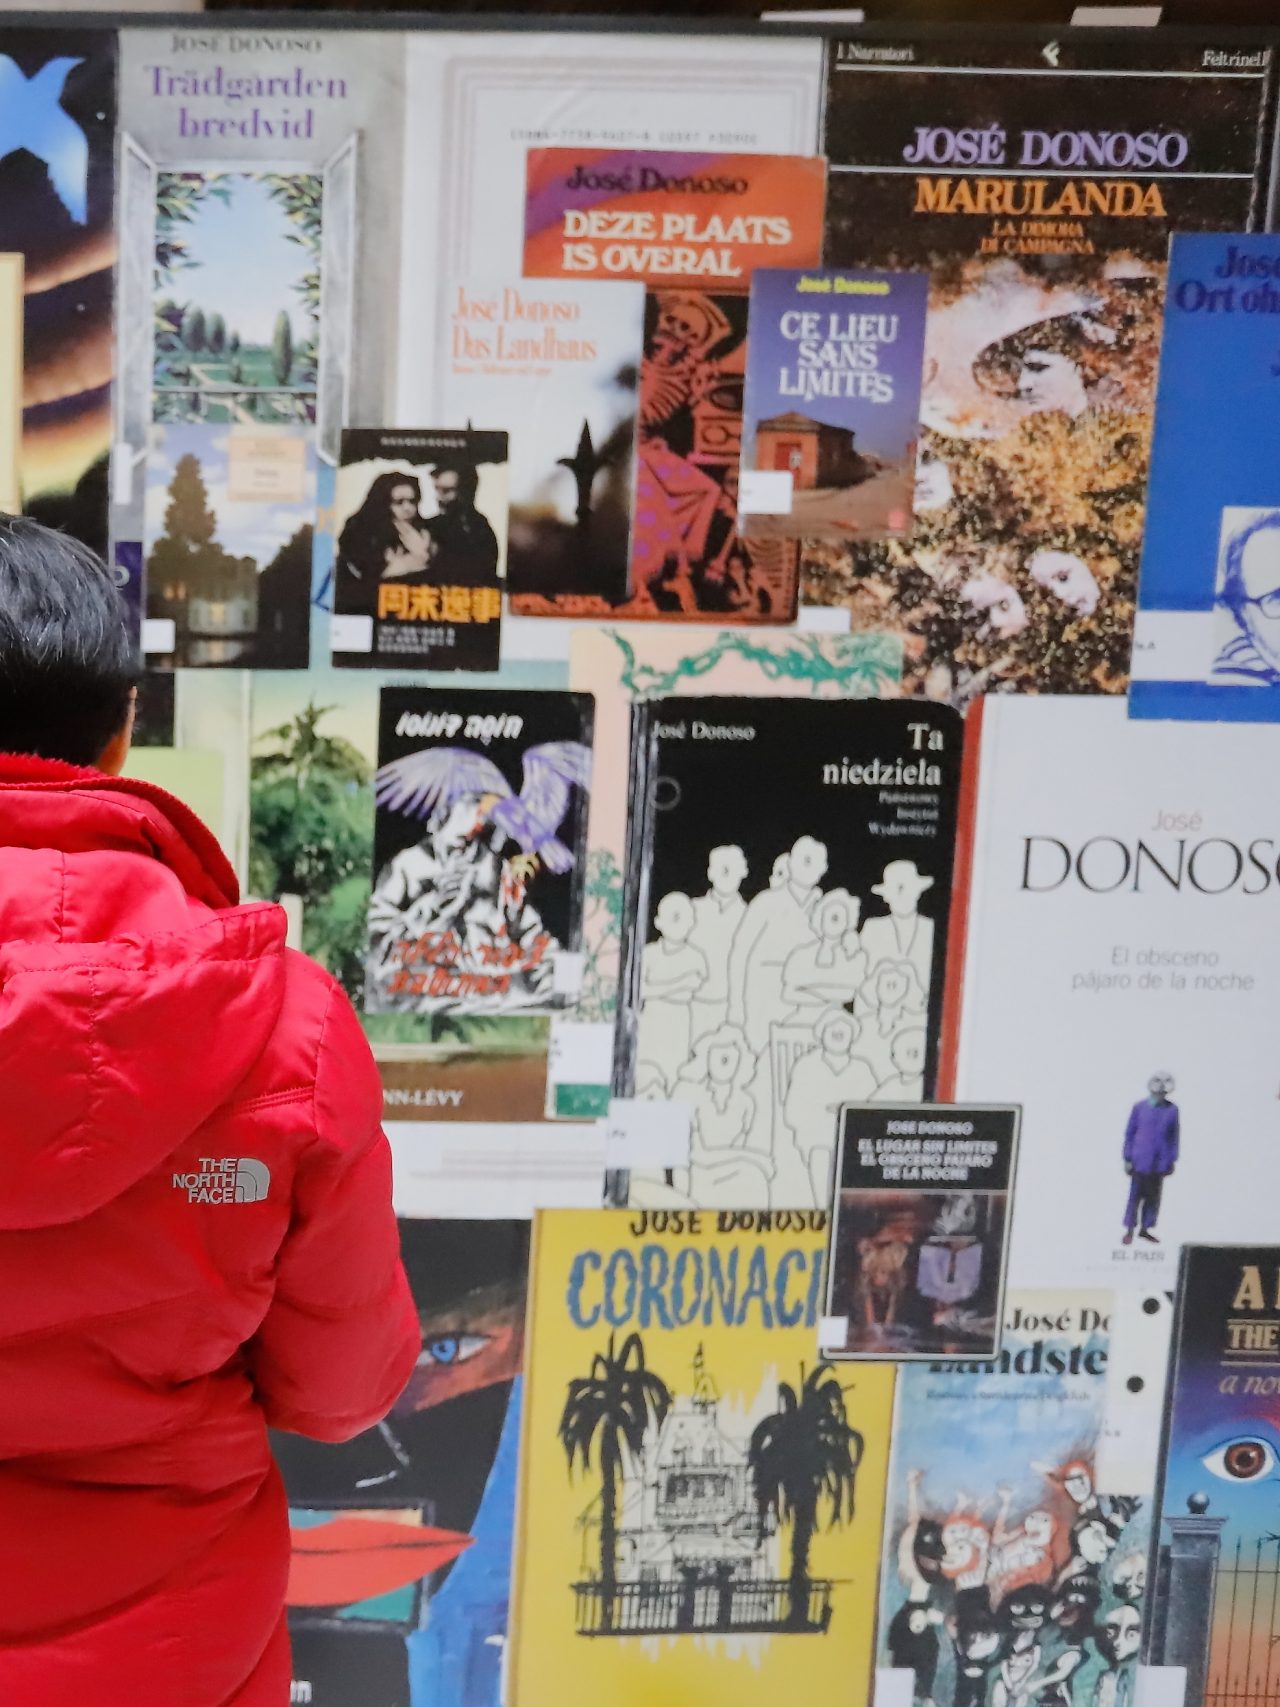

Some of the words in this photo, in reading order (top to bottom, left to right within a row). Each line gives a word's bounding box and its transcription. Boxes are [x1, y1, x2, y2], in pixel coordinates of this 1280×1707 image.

[179, 107, 314, 139] bredvid
[903, 123, 1007, 165] JOSÉ
[1020, 130, 1188, 168] DONOSO
[566, 166, 634, 192] José
[639, 167, 749, 196] Donoso
[913, 176, 1169, 219] MARULANDA
[563, 209, 657, 241] DEZE
[663, 213, 793, 246] PLAATS
[562, 242, 598, 272] IS
[602, 246, 743, 278] OVERAL
[1214, 245, 1280, 279] Jos
[1176, 280, 1235, 313] Ort
[779, 310, 821, 341] CE
[828, 312, 899, 343] LIEU
[797, 339, 879, 370] SANS
[778, 367, 894, 403] LIMITES
[692, 721, 757, 741] Donoso
[907, 722, 944, 751] Ta
[822, 757, 942, 786] niedziela
[1151, 810, 1204, 832] José
[1019, 834, 1280, 896] DONOS
[1111, 946, 1130, 966] El
[1135, 947, 1220, 968] obsceno
[1071, 969, 1132, 993] pájaro
[1137, 970, 1163, 990] de
[1170, 971, 1187, 990] la
[1193, 971, 1255, 991] noche
[199, 1157, 237, 1172] THE
[172, 1173, 235, 1188] NORTH
[188, 1187, 234, 1204] FACE
[1005, 1308, 1070, 1332] José
[1227, 1325, 1280, 1349] THE
[1219, 1375, 1239, 1395] a
